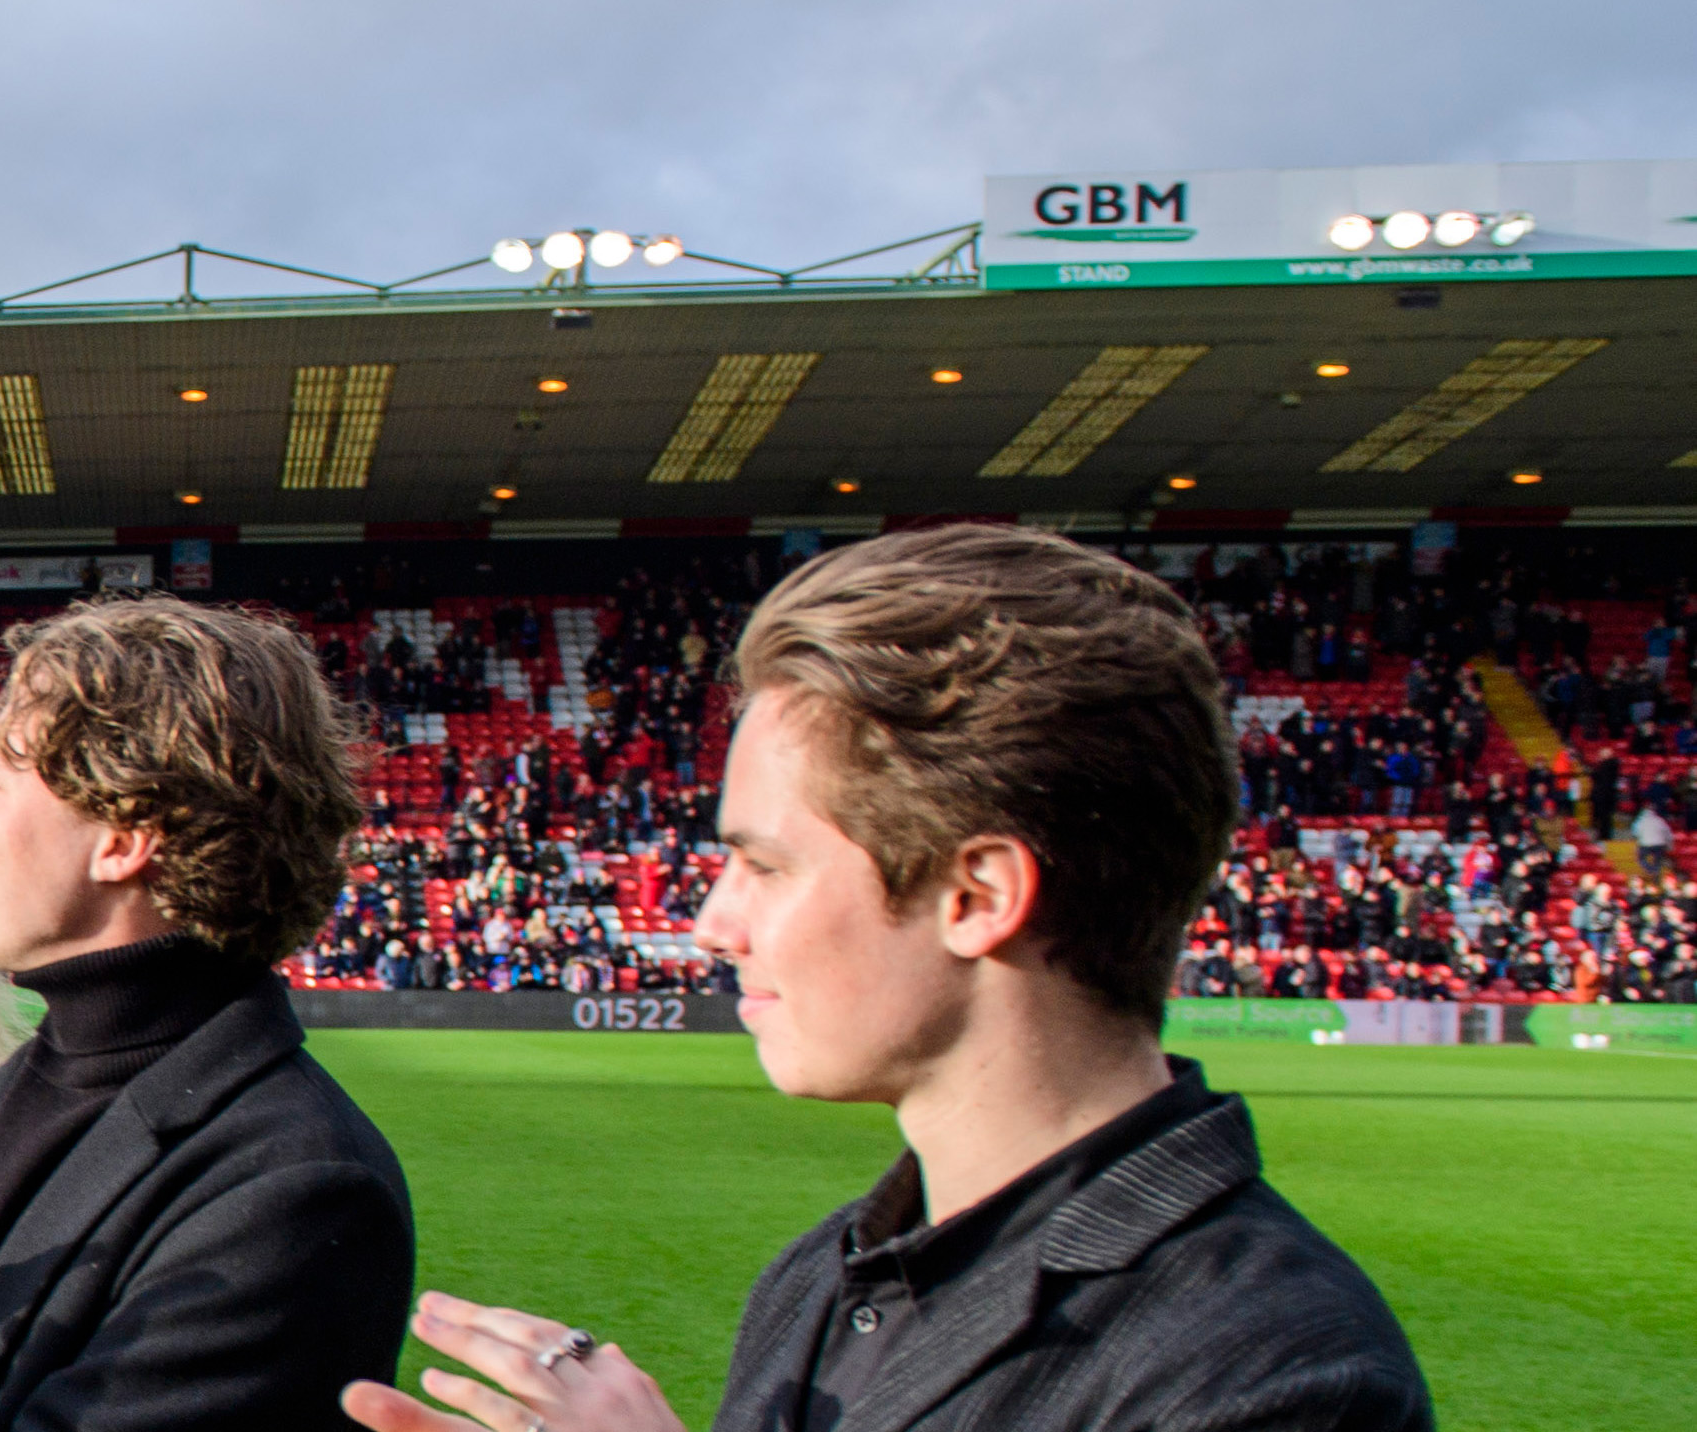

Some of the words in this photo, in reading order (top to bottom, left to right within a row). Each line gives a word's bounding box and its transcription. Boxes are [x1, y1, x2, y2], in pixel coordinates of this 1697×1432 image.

[1034, 182, 1188, 226] GBM
[1058, 264, 1131, 284] STAND
[1288, 253, 1534, 281] www.gbmwaste.co.uk
[573, 997, 686, 1031] 01522
[1250, 1003, 1334, 1023] Source
[1611, 1007, 1694, 1026] Source
